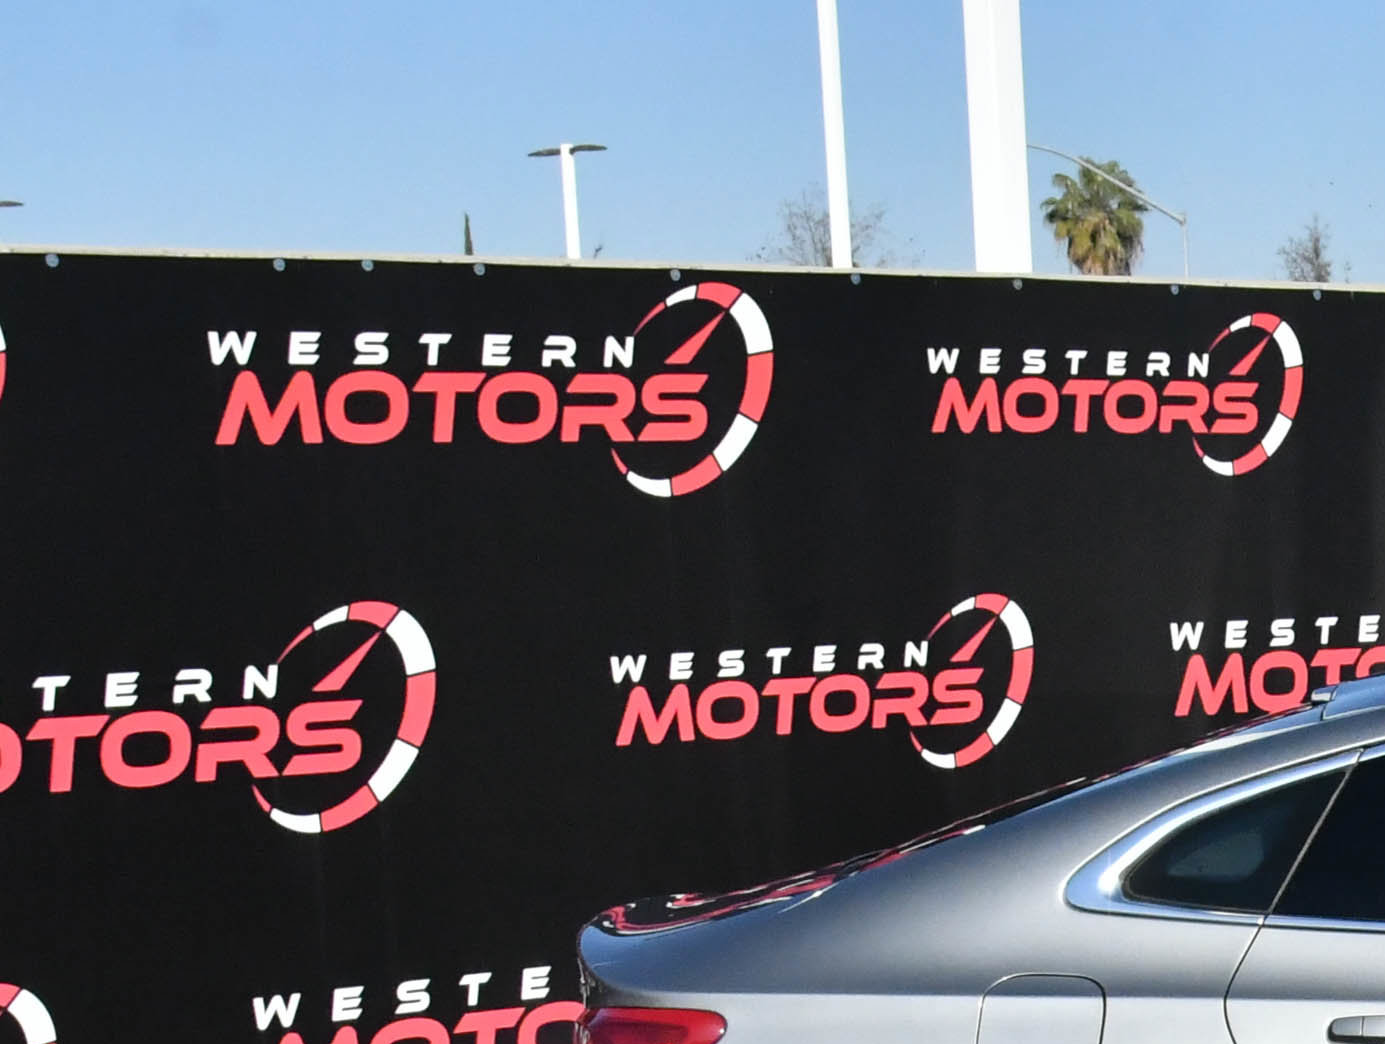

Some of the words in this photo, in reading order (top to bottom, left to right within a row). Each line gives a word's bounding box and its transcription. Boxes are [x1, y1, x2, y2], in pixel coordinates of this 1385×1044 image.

[208, 331, 636, 369] WESTERN
[927, 347, 1209, 378] WESTERN
[215, 369, 709, 446] MOTORS
[931, 376, 1259, 434] MOTORS
[32, 664, 279, 712] TERN
[610, 640, 930, 684] WESTERN
[615, 667, 985, 747] MOTORS
[0, 699, 364, 794] TORS
[252, 965, 552, 1031] WESTE
